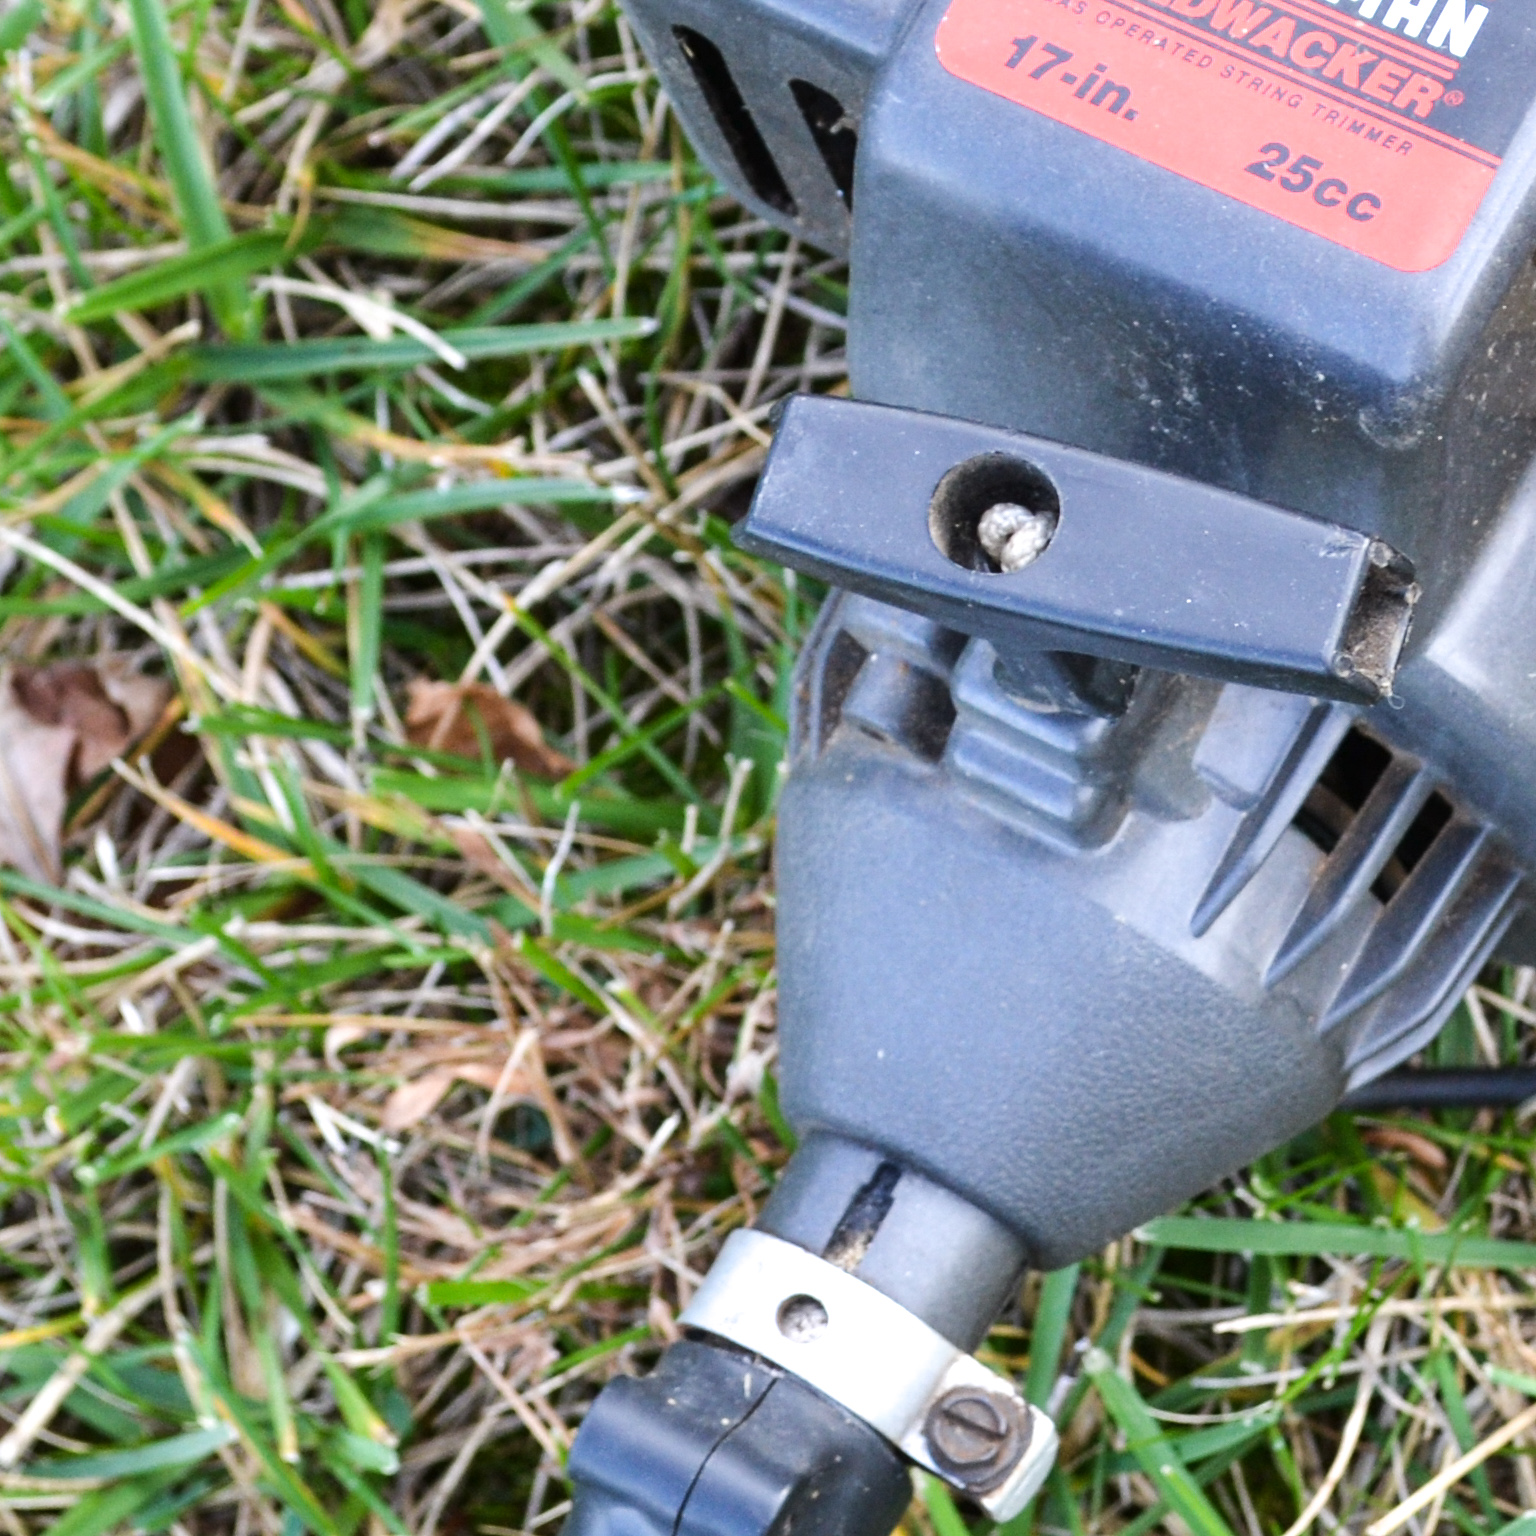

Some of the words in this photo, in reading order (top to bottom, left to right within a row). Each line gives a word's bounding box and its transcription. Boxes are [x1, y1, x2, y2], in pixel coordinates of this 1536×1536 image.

[1003, 35, 1139, 121] 17-in.
[1245, 142, 1381, 222] 25cc
[1097, 11, 1212, 68] OPERATED
[1221, 65, 1302, 109] STRING
[1312, 104, 1414, 155] TRIMMER
